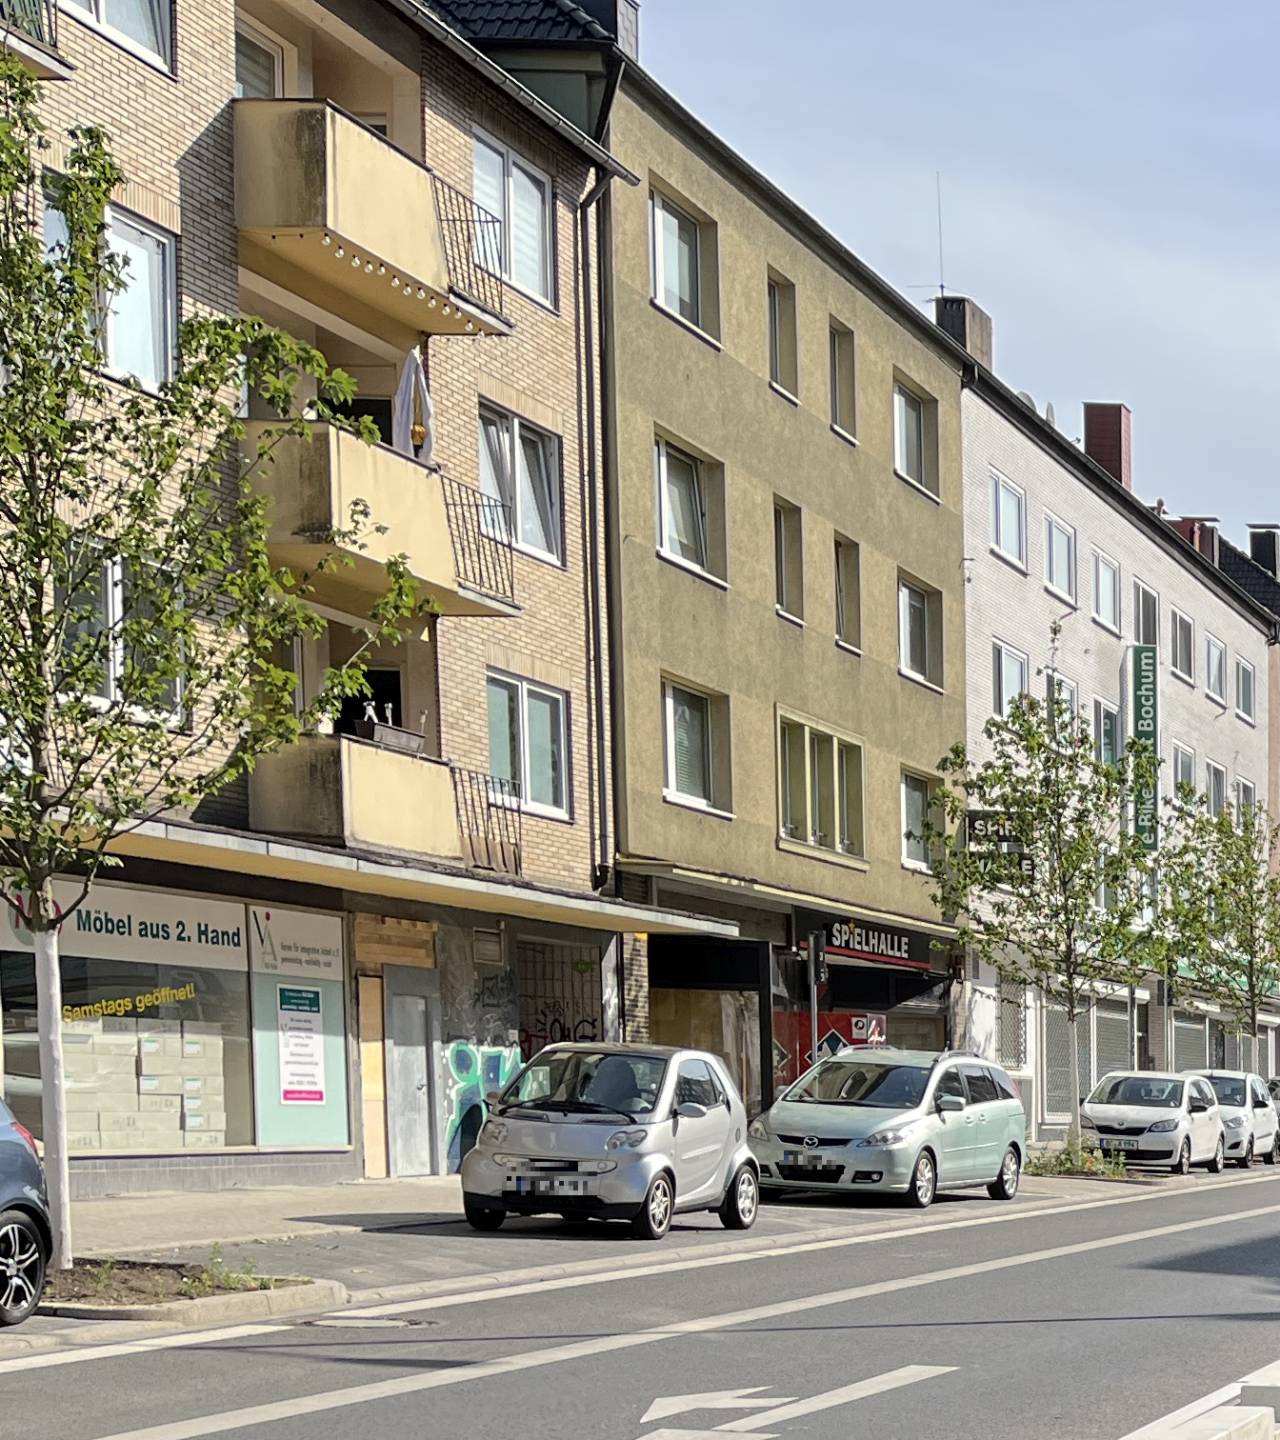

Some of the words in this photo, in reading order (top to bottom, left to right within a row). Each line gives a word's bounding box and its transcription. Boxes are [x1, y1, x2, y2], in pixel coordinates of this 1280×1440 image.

[1137, 652, 1154, 731] Bochum
[76, 908, 132, 937] Möbel
[138, 921, 170, 940] aus
[176, 920, 191, 942] 2.
[197, 922, 241, 947] Hand
[62, 996, 132, 1023] Samstags
[136, 982, 196, 1013] geöffnet!
